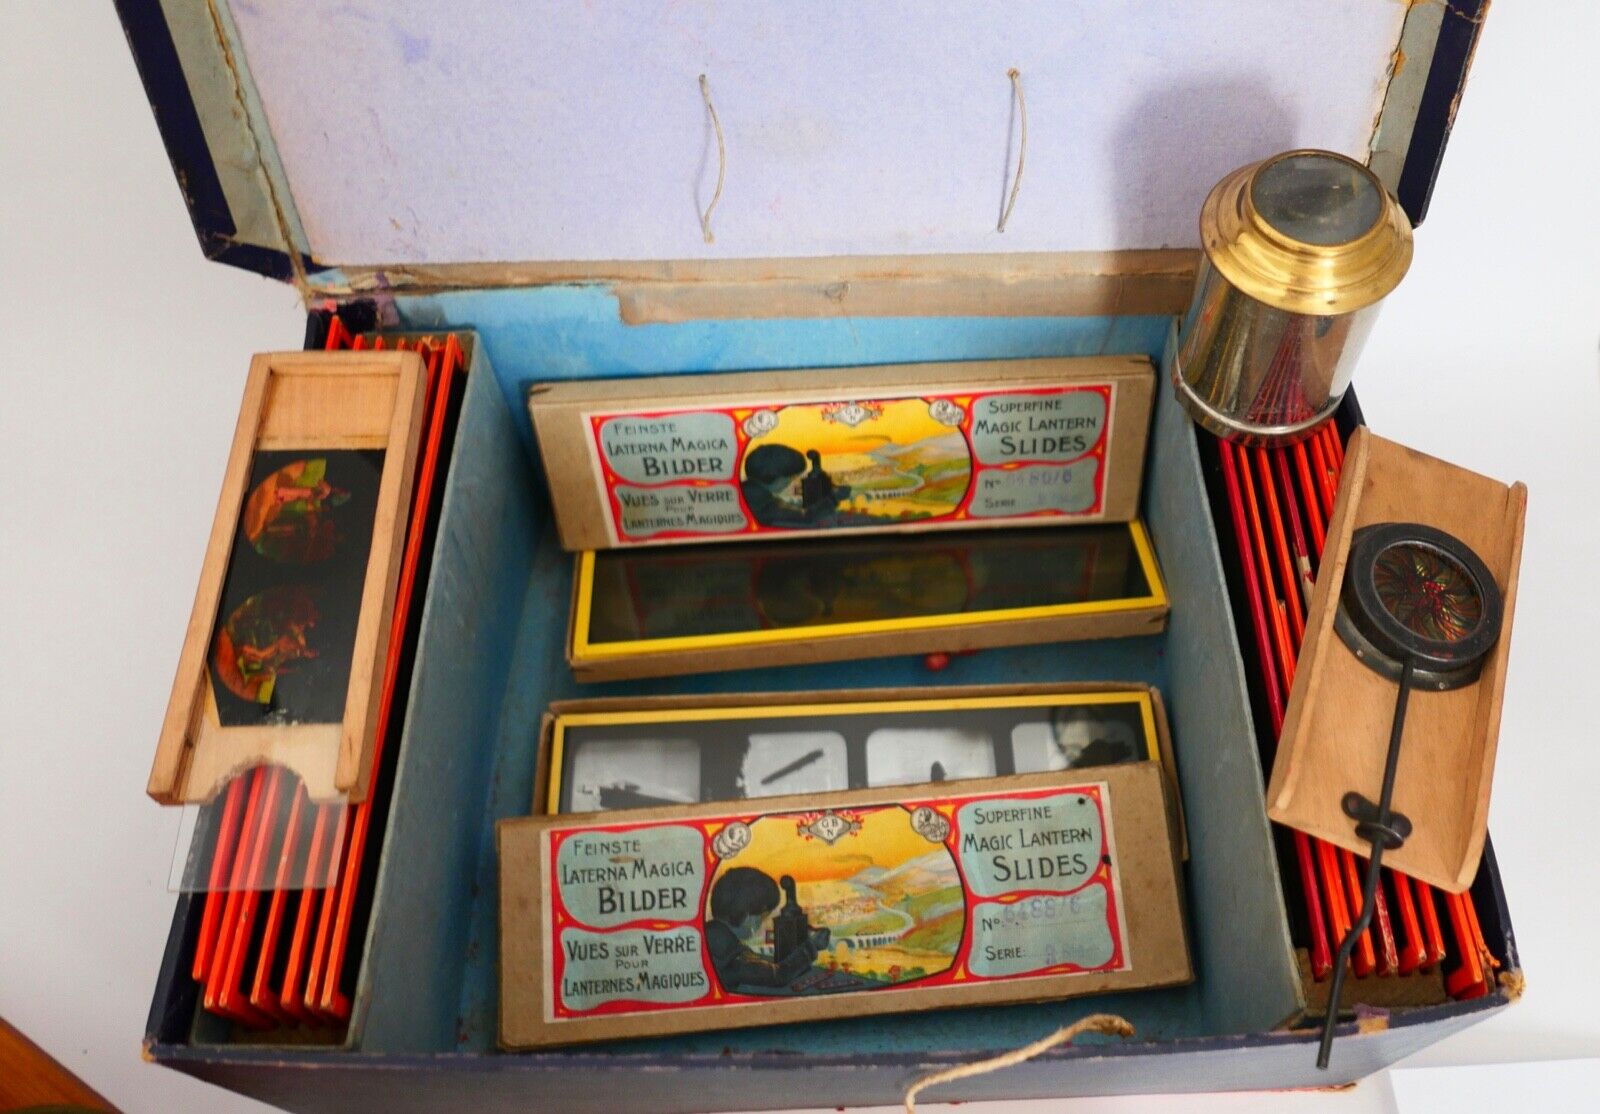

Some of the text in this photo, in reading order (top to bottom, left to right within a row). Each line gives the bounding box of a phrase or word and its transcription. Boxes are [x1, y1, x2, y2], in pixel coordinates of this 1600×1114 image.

[988, 400, 1062, 414] SUPERFINE
[613, 422, 677, 436] FEINSTE
[975, 416, 1096, 435] MAGIC LANTERN
[607, 437, 728, 457] LATERNA MAGICA
[1000, 435, 1087, 456] SLIDES
[643, 456, 723, 477] BILDER
[620, 492, 660, 507] VUES
[687, 490, 731, 503] VERRE
[624, 512, 743, 530] LANTERNES MAGIQUES
[974, 806, 1053, 825] SUPERFINE
[573, 839, 641, 856] FEINSTE
[963, 827, 1093, 854] MAGIC LANTERN
[563, 858, 695, 886] LATERNA MAGICA
[993, 853, 1088, 882] SLIDES
[598, 886, 687, 915] BILDER
[566, 935, 697, 961] VUES SUR VERRE
[615, 959, 649, 970] POUR
[564, 971, 705, 997] LANTERNES MAGIQUES
